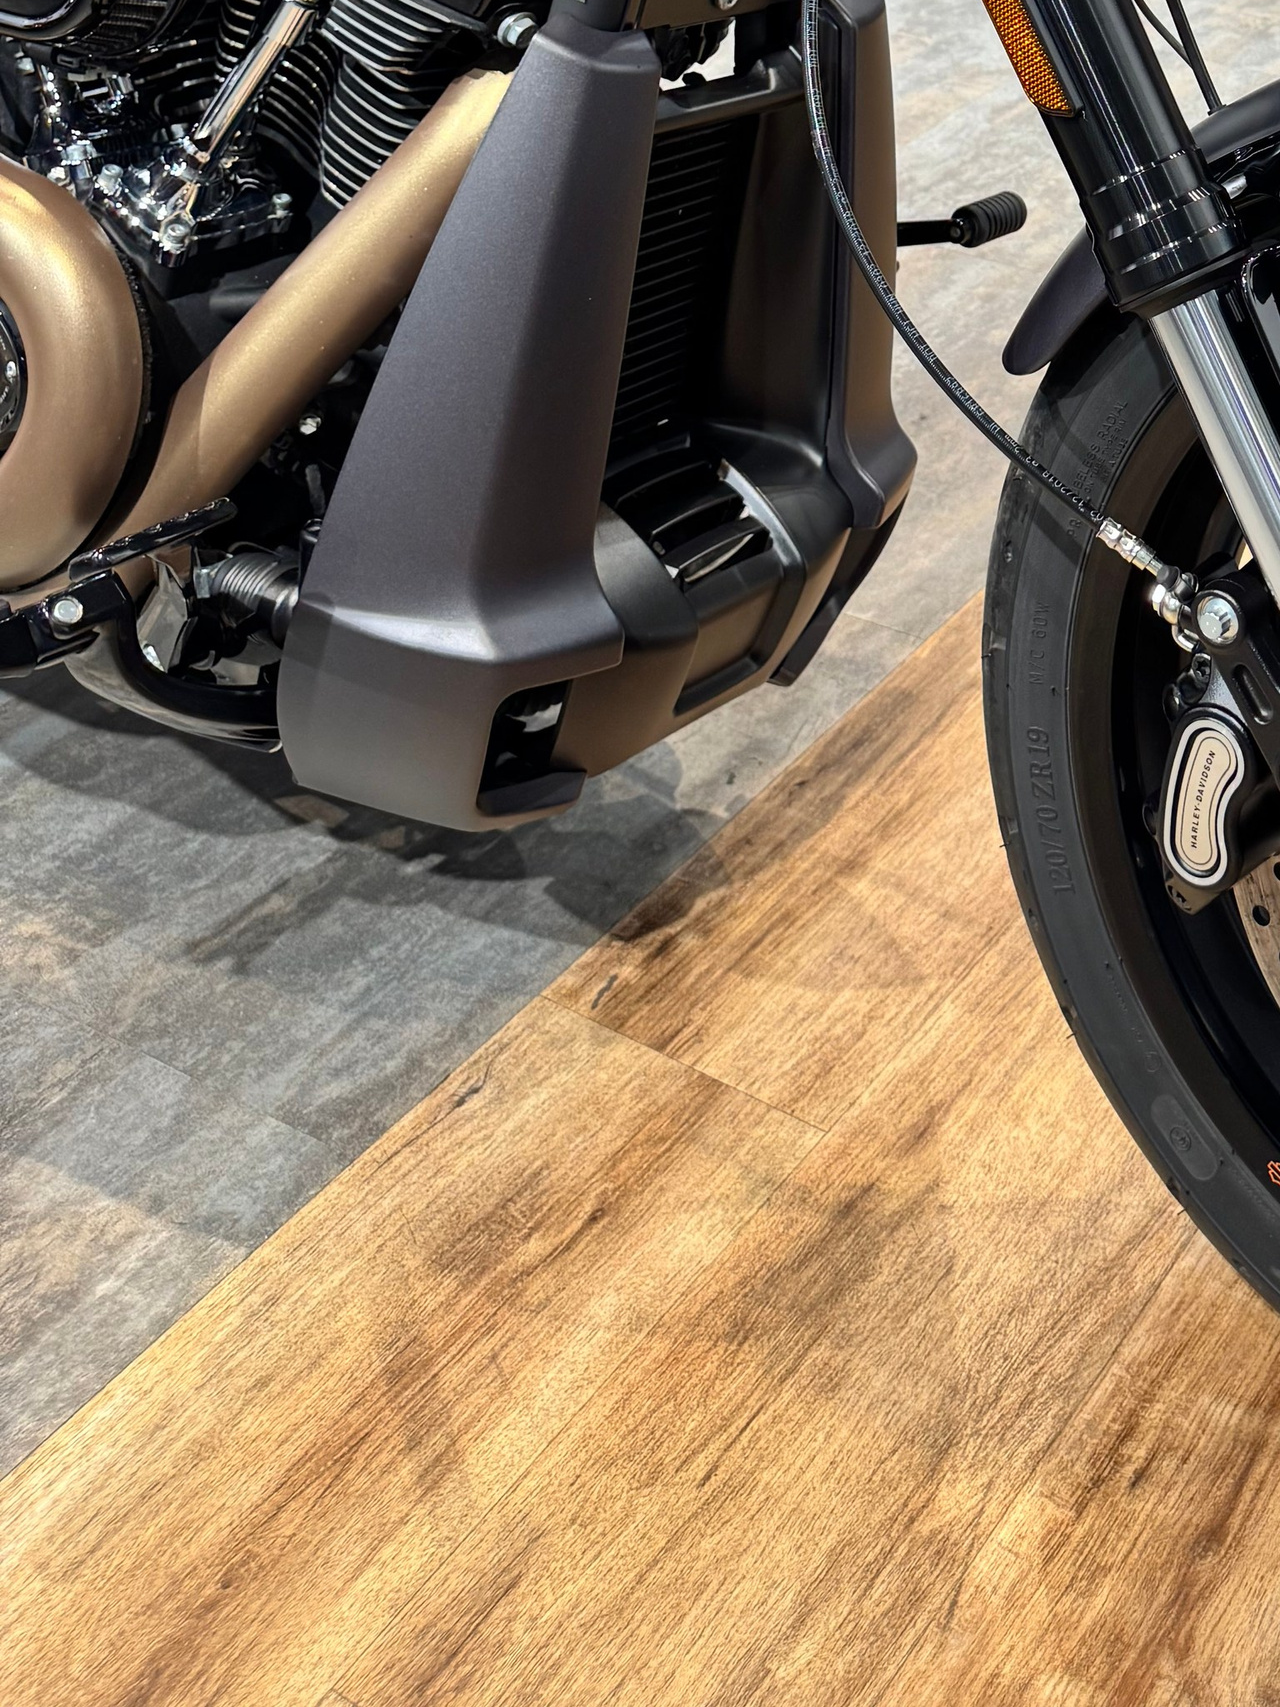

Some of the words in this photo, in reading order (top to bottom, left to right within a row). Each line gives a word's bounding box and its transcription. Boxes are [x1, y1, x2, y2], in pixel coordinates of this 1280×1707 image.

[1027, 726, 1056, 802] ZR19
[1191, 748, 1217, 850] HARLEY-DAVIDSON
[1036, 805, 1076, 896] 120/70
